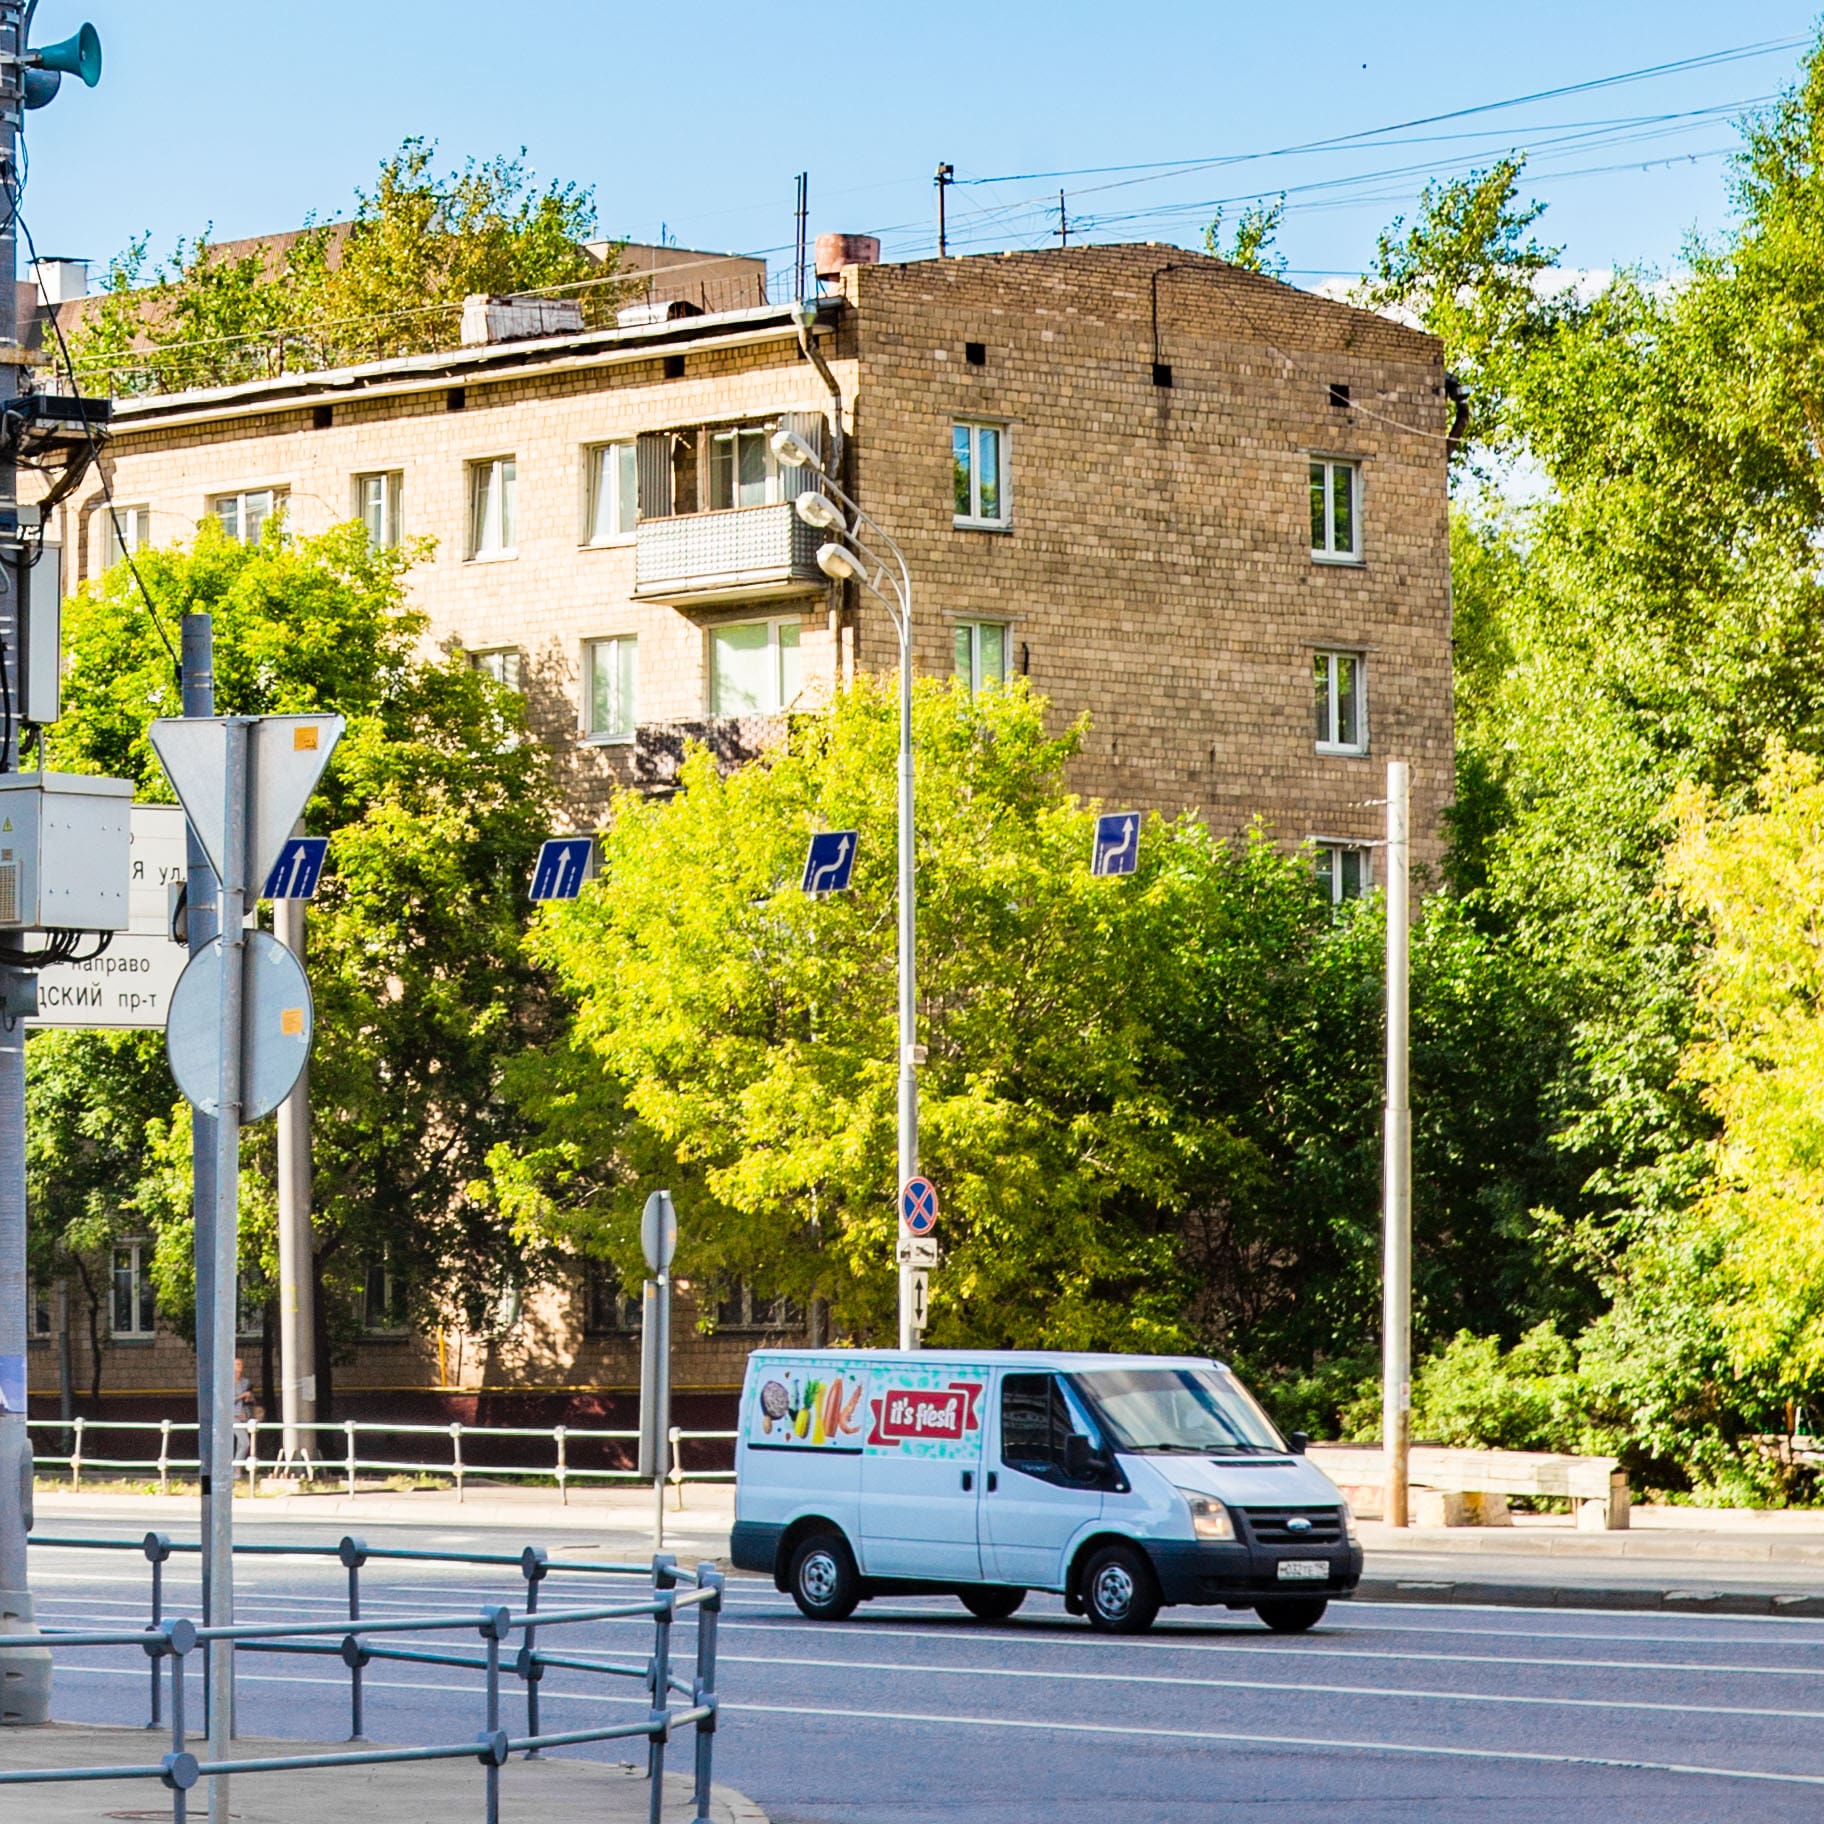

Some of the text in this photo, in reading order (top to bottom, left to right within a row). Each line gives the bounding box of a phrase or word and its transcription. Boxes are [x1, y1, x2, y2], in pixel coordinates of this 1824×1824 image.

[119, 992, 157, 1013] пр-т
[890, 1396, 959, 1432] it's fresh
